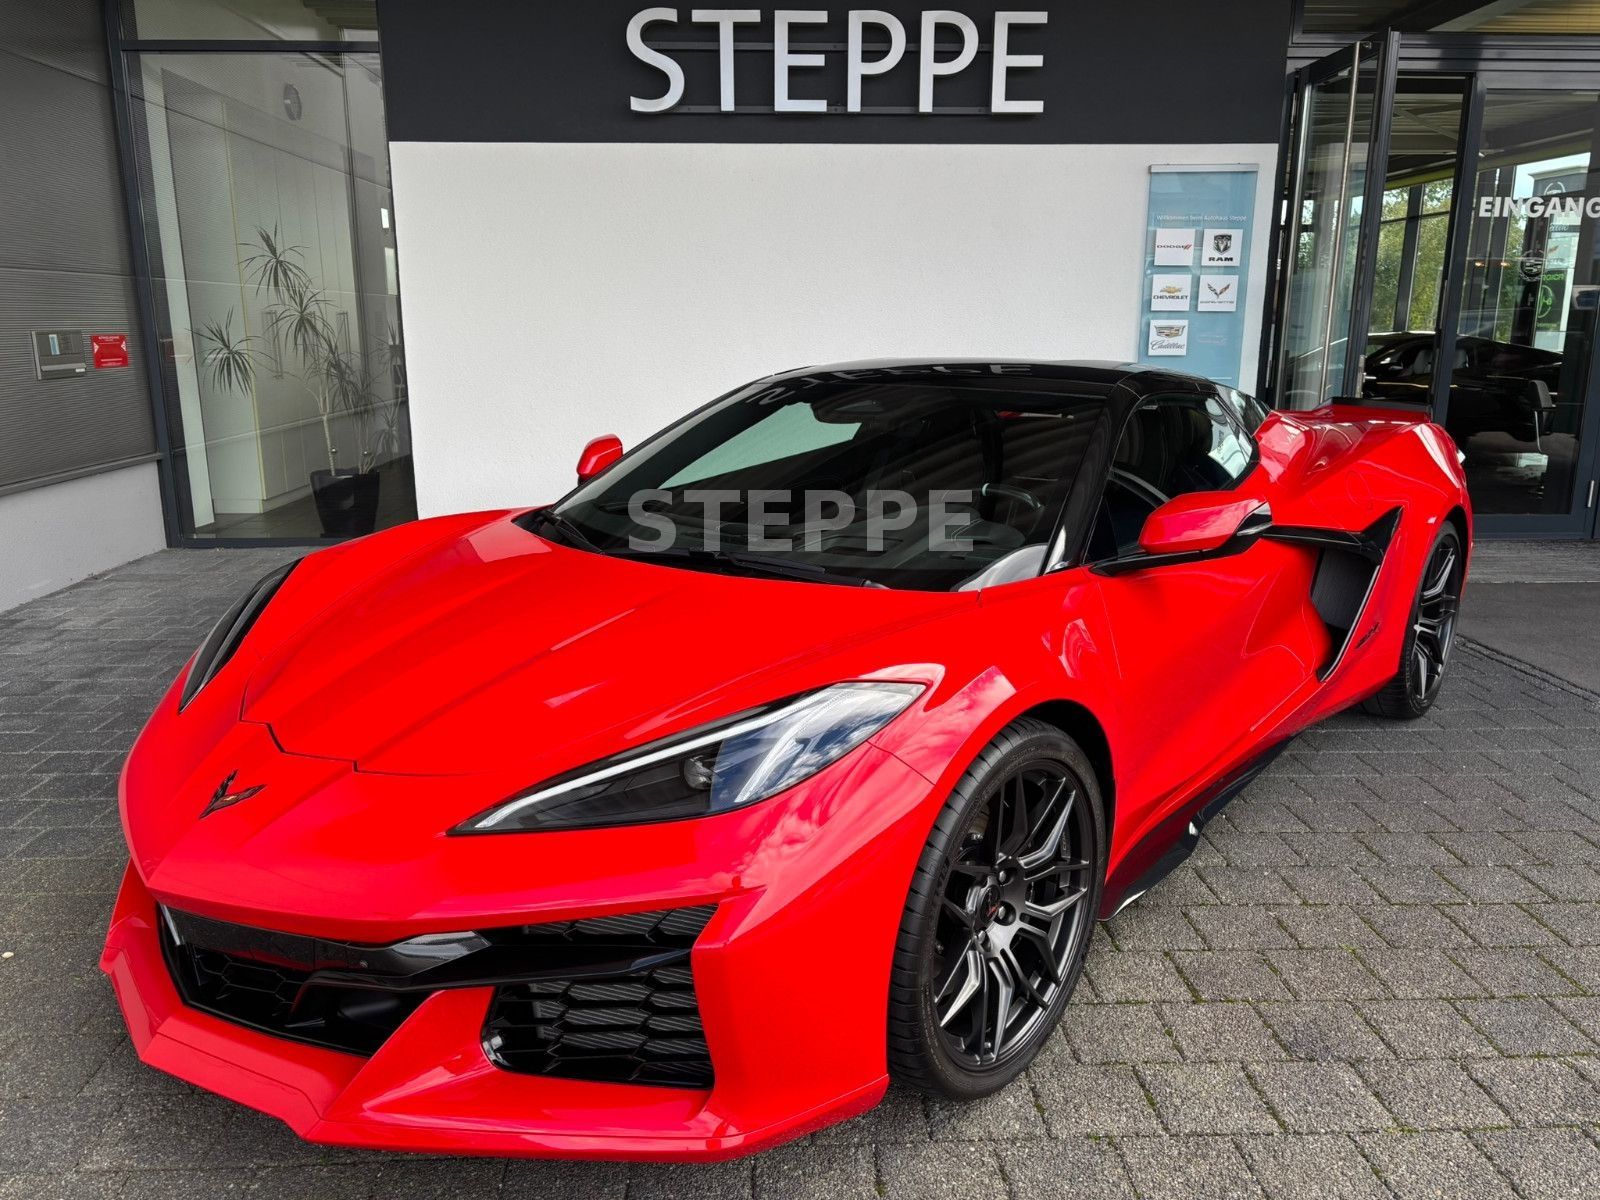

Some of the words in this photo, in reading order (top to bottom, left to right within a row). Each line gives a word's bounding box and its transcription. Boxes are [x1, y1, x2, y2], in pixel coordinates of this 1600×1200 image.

[625, 7, 1048, 114] STEPPE
[1478, 197, 1600, 218] EINGANG
[1150, 340, 1185, 350] Cadillac
